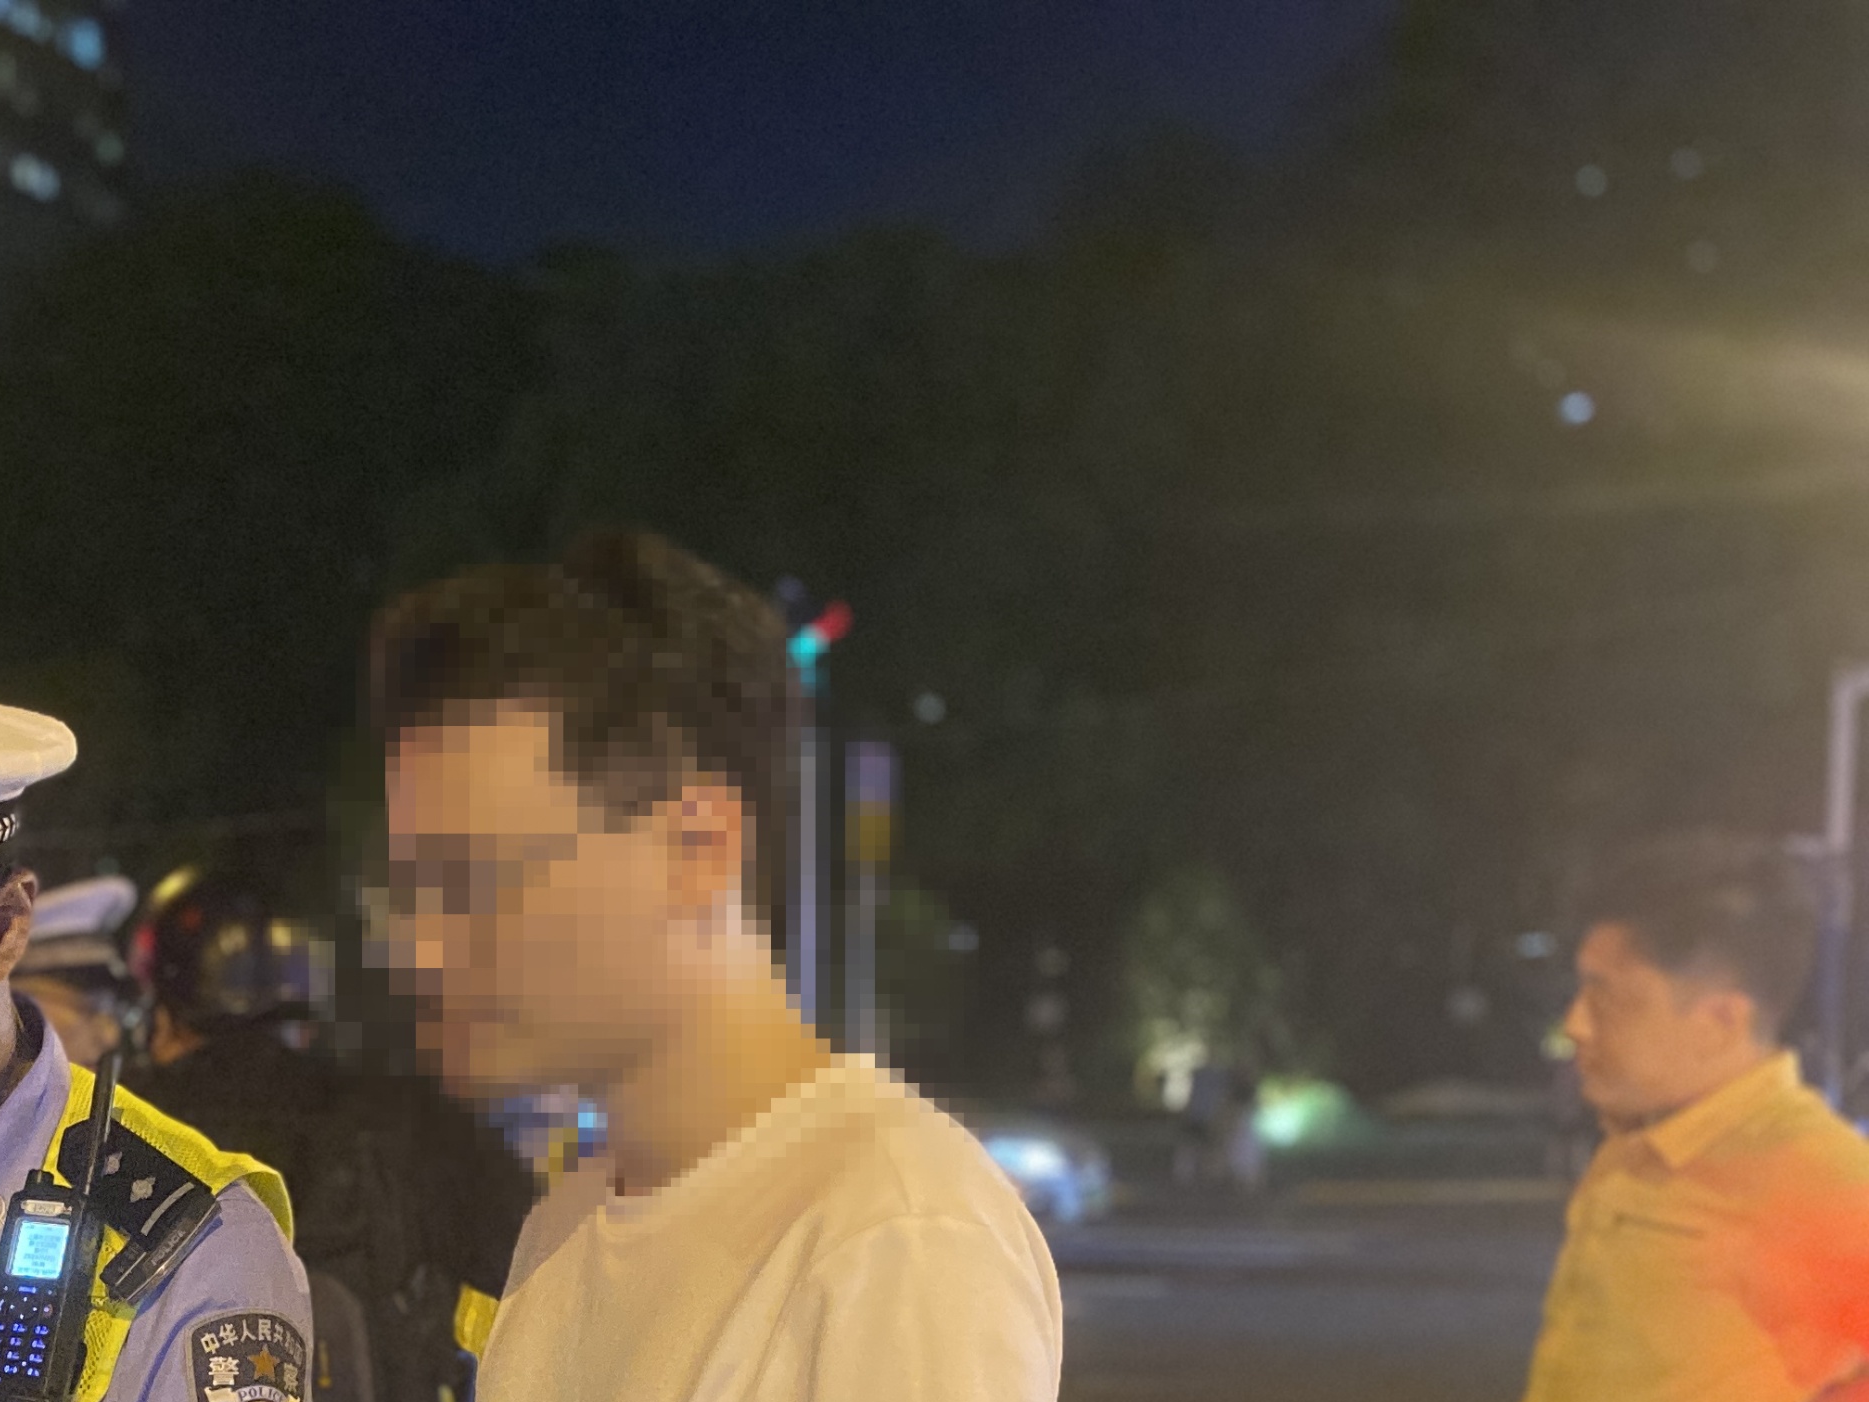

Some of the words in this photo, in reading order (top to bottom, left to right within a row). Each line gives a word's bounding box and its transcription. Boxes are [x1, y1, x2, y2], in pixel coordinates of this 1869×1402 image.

[200, 1318, 307, 1366] 中华人民共和国
